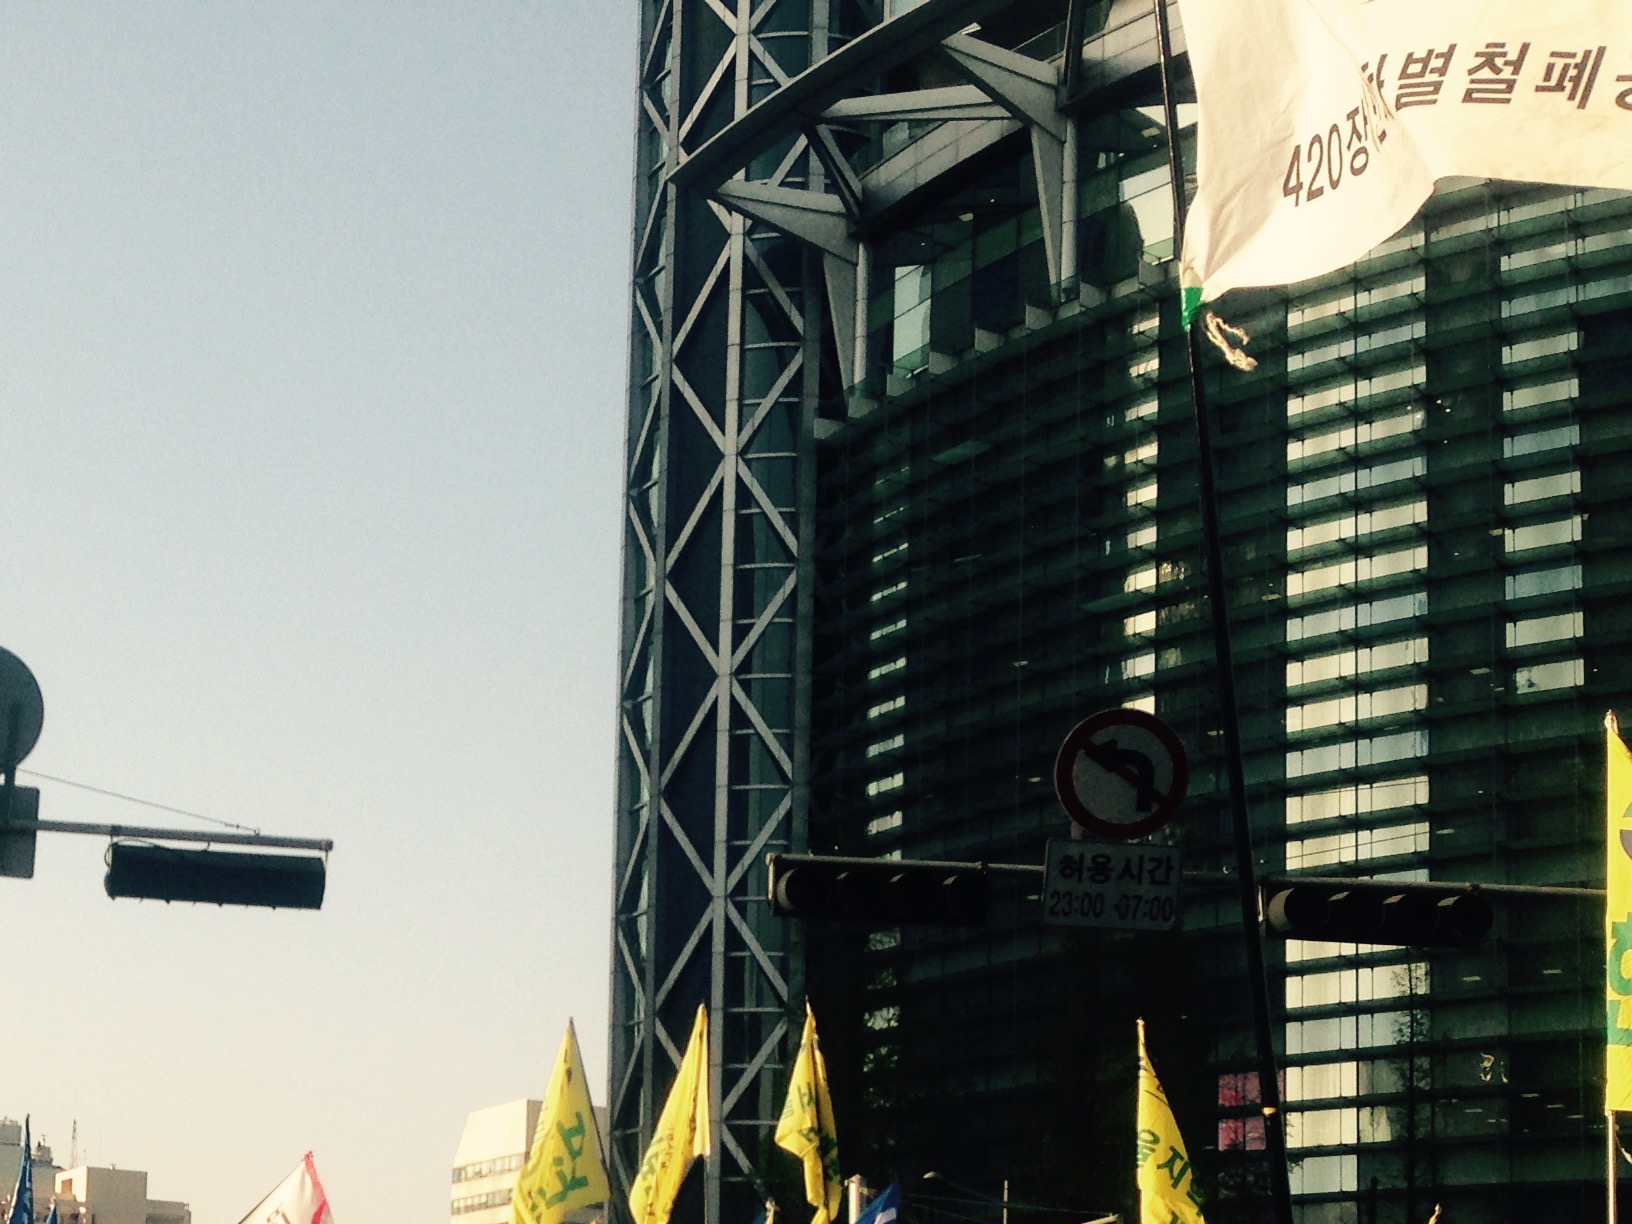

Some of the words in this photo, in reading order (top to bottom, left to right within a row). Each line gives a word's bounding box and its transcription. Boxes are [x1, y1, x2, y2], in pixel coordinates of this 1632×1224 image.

[1360, 41, 1632, 112] 별철폐
[1058, 852, 1175, 886] 허용시간
[1048, 889, 1105, 919] 23:00
